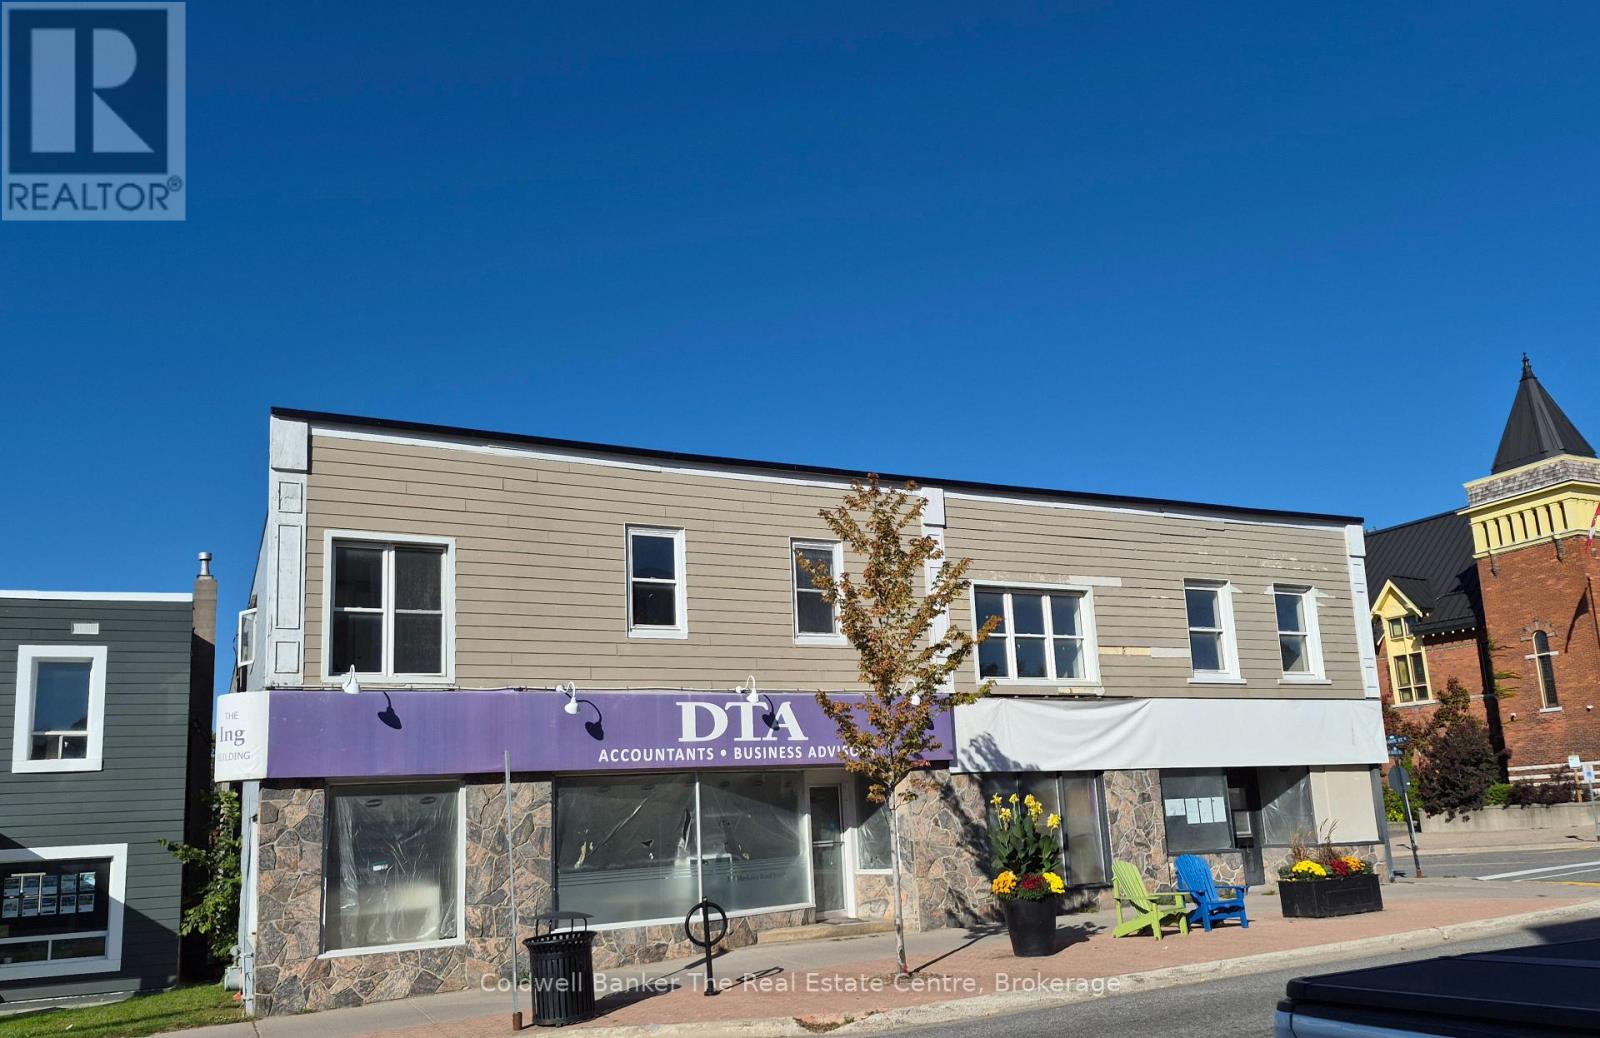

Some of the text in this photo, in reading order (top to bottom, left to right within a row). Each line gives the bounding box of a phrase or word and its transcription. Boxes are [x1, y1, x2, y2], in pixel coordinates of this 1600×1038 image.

[224, 711, 239, 720] THE
[675, 701, 809, 743] DTA
[219, 726, 246, 747] Ing
[217, 751, 251, 761] ILDING
[598, 744, 876, 763] ACCOUNTANTS BUSINESS ADVISO
